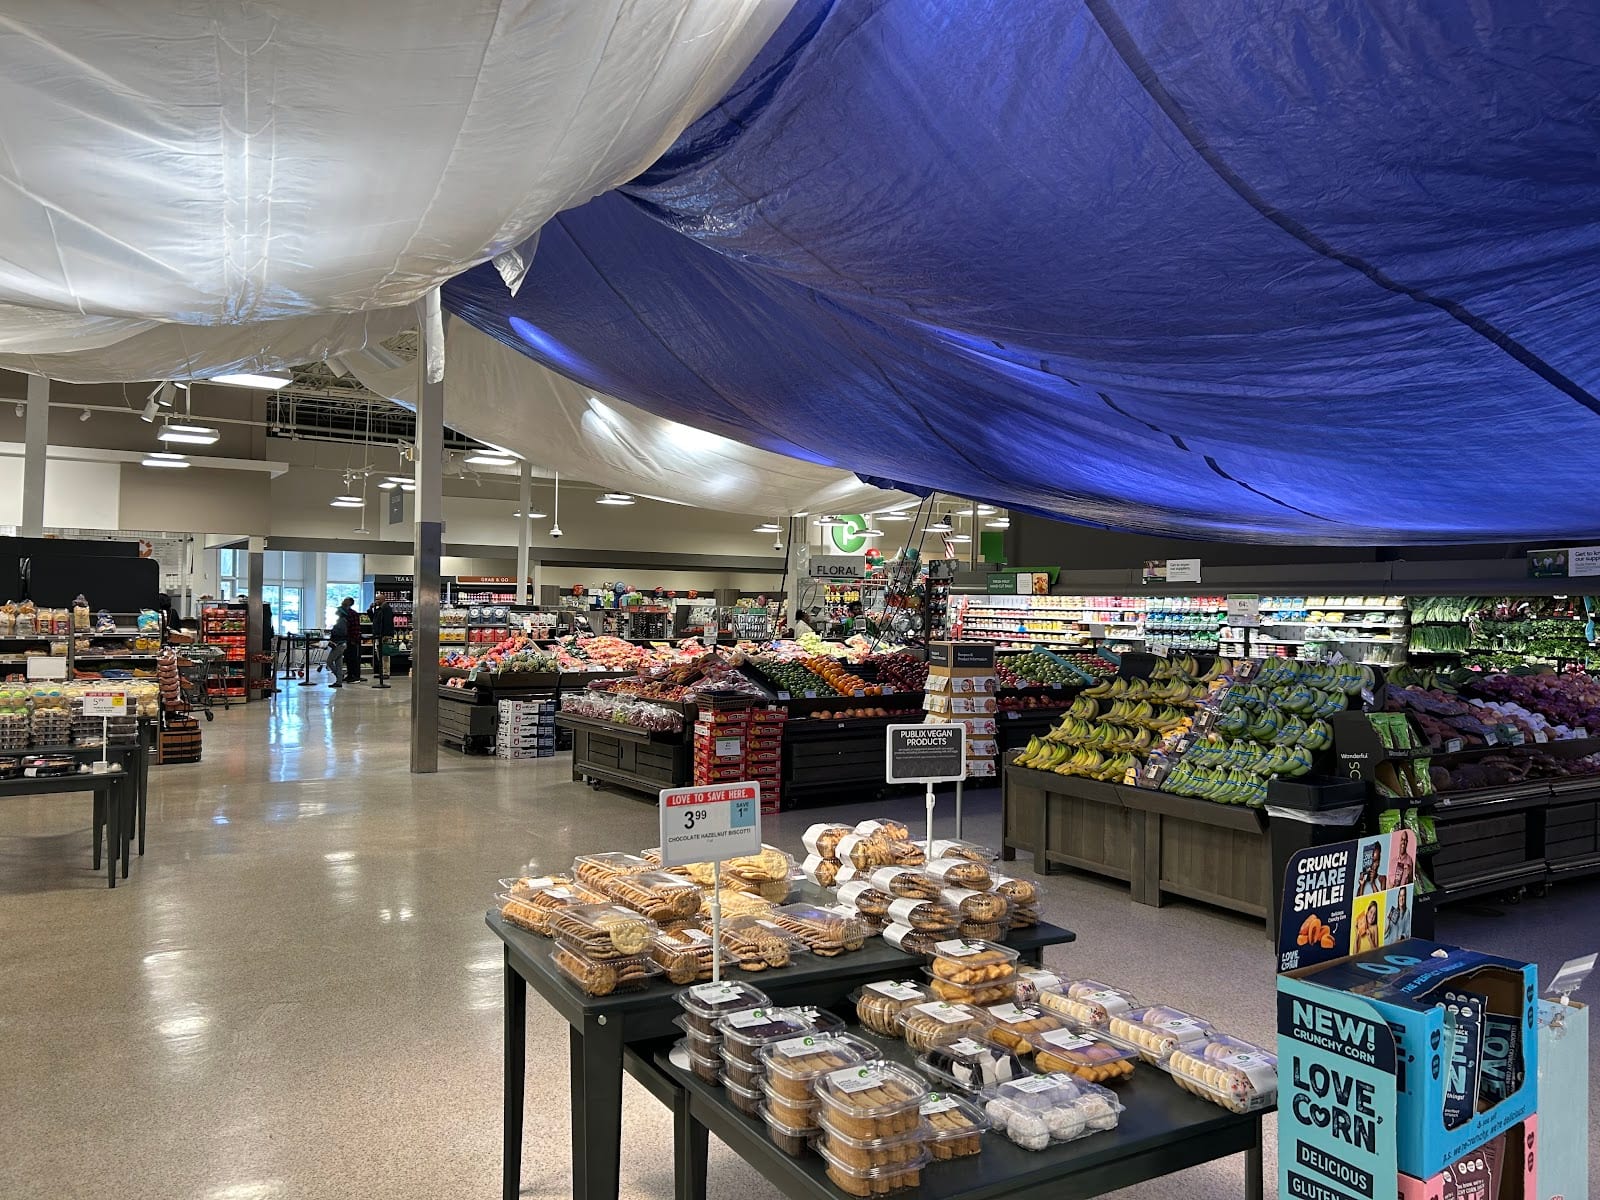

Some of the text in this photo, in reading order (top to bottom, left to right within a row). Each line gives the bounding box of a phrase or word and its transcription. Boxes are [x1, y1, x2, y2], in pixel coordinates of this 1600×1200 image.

[816, 566, 859, 576] FLORAL
[907, 738, 947, 746] PRODUCTS
[672, 789, 749, 805] LOVE TO SAVE HERE.
[668, 834, 700, 843] CHOCOLATE
[729, 828, 751, 836] BISCOTTI
[1297, 851, 1348, 874] CRUNCH
[1295, 866, 1346, 893] SHARE
[1293, 884, 1344, 912] SMILE!
[1400, 982, 1418, 994] THE
[1292, 1000, 1376, 1052] NEW!
[1293, 1027, 1375, 1064] CRUNCHY CORN
[1479, 1021, 1512, 1100] LOVE
[1301, 1147, 1368, 1190] DELICIOUS
